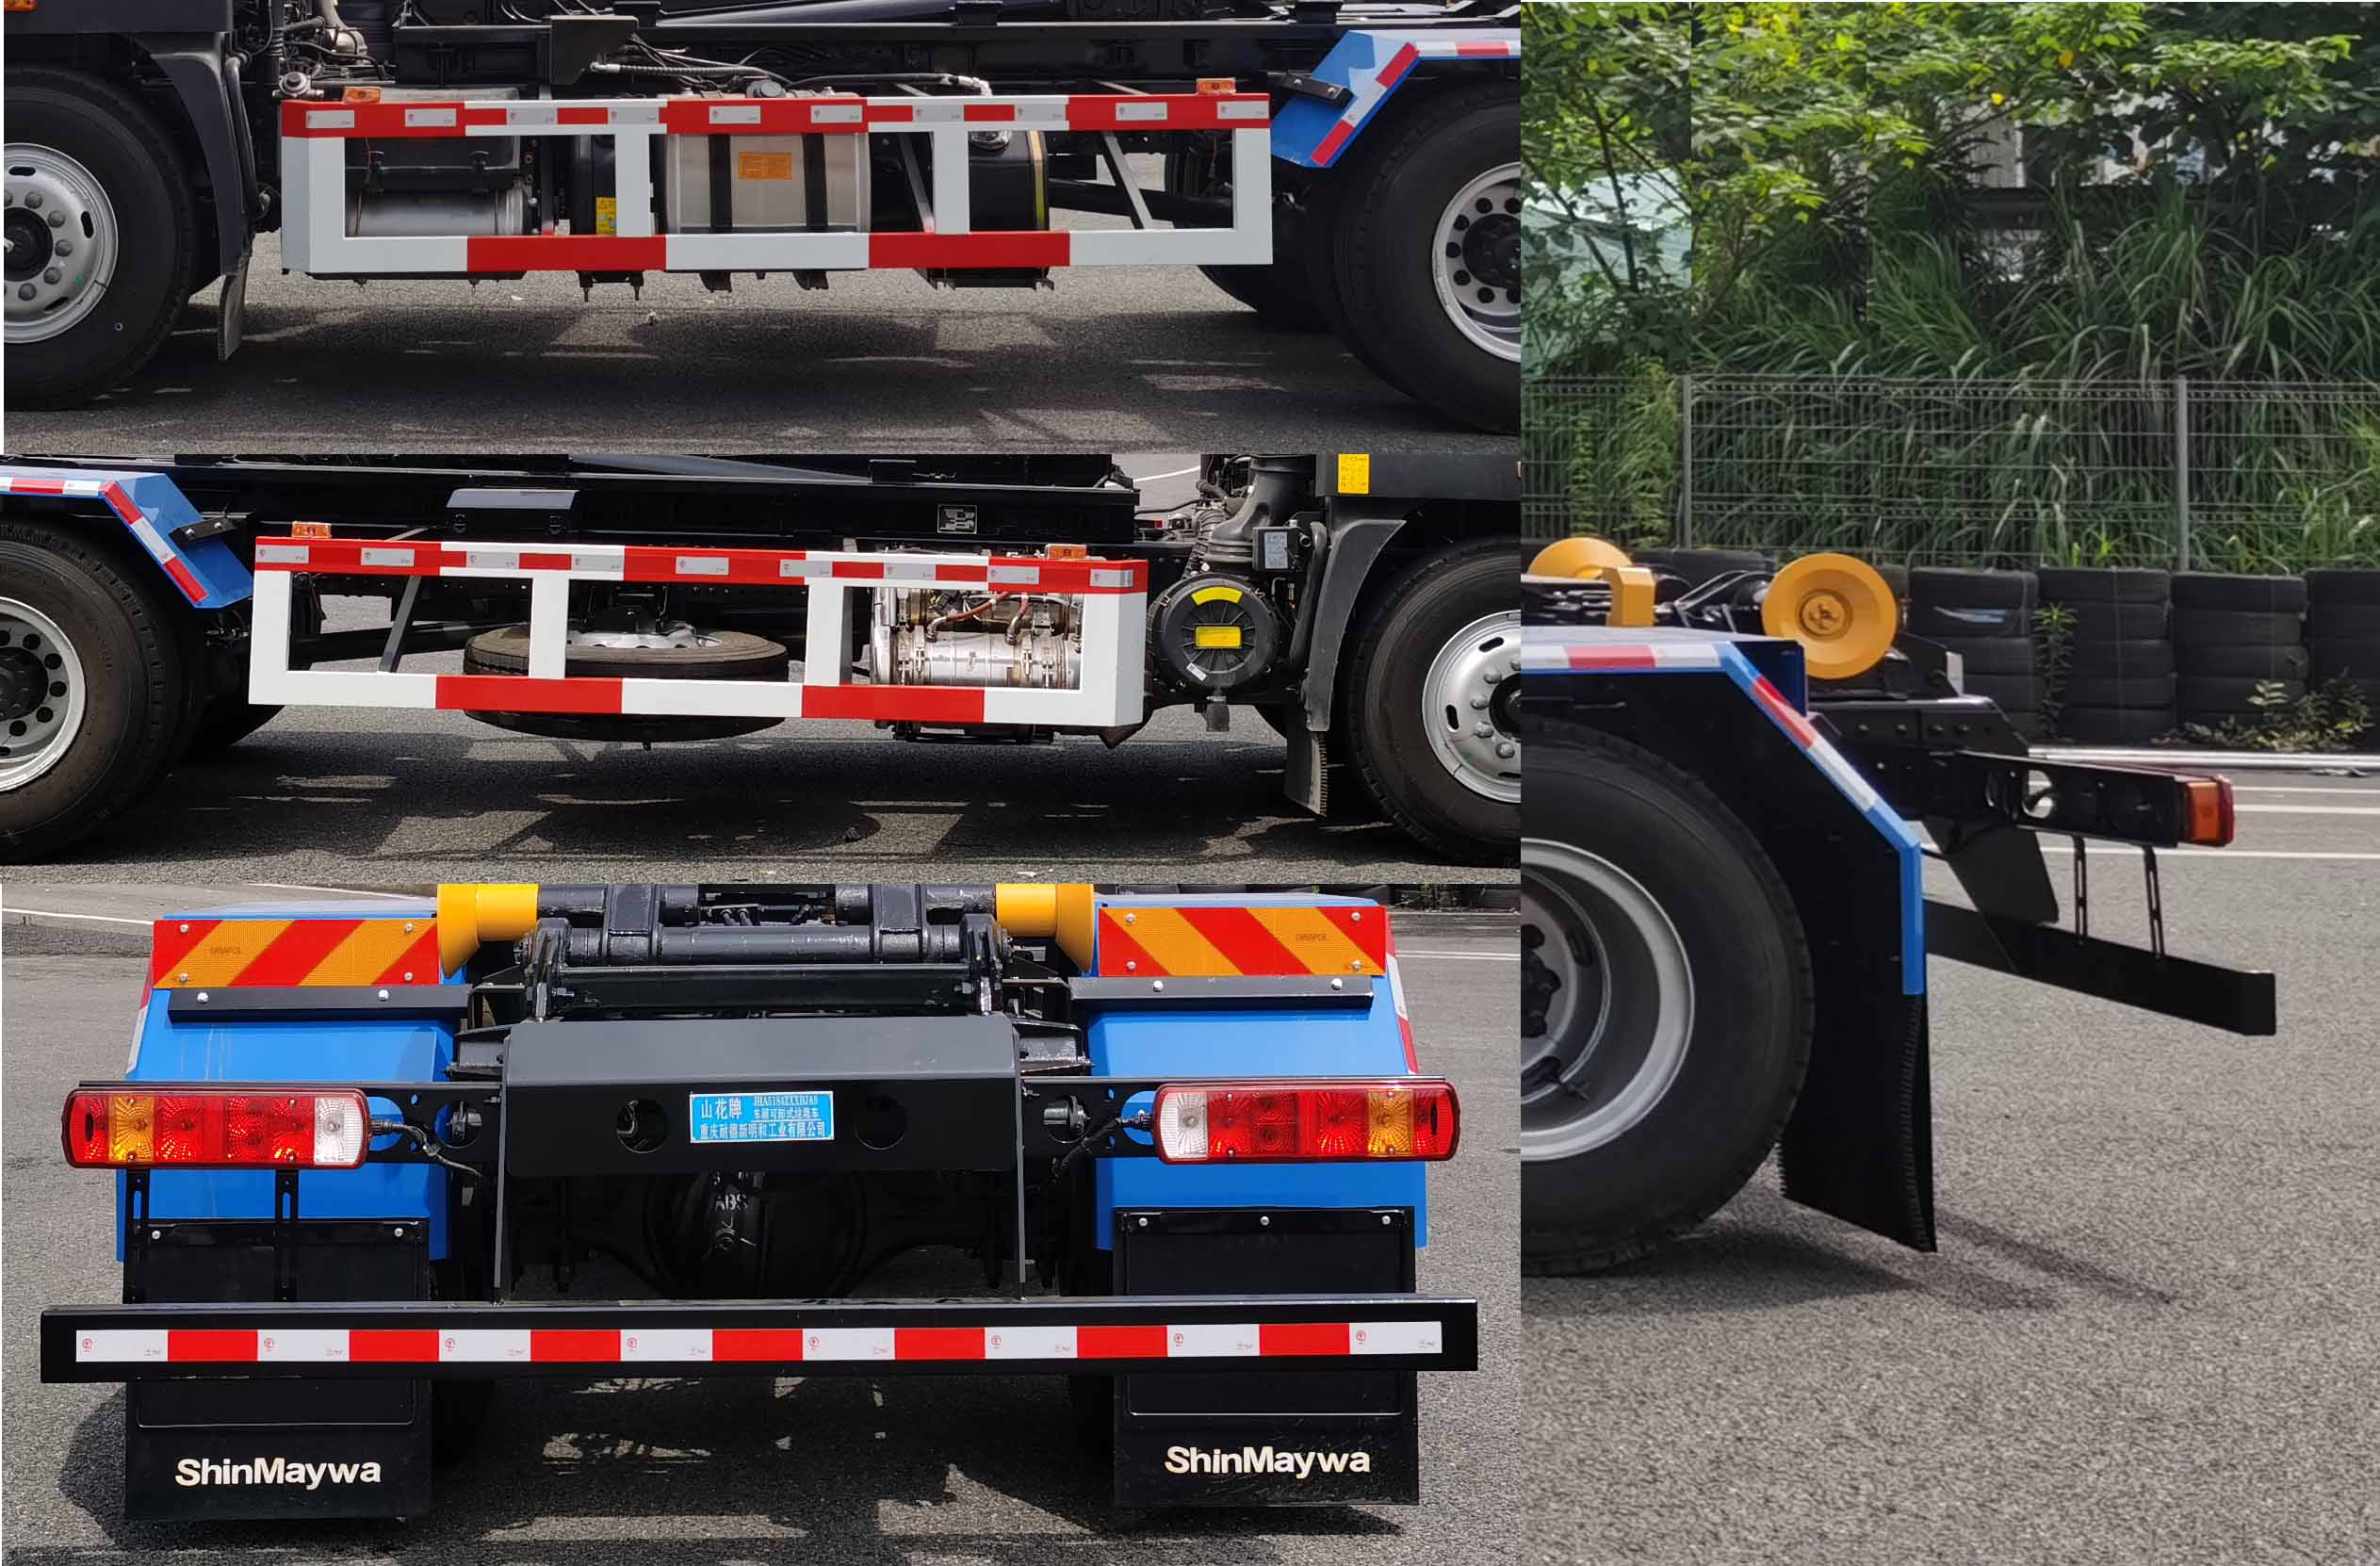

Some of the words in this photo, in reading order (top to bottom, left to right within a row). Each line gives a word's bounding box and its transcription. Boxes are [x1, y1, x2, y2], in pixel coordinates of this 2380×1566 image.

[700, 1098, 742, 1119] 山花牌
[174, 1457, 381, 1491] ShinMaywa
[1165, 1445, 1371, 1479] ShinMaywa
